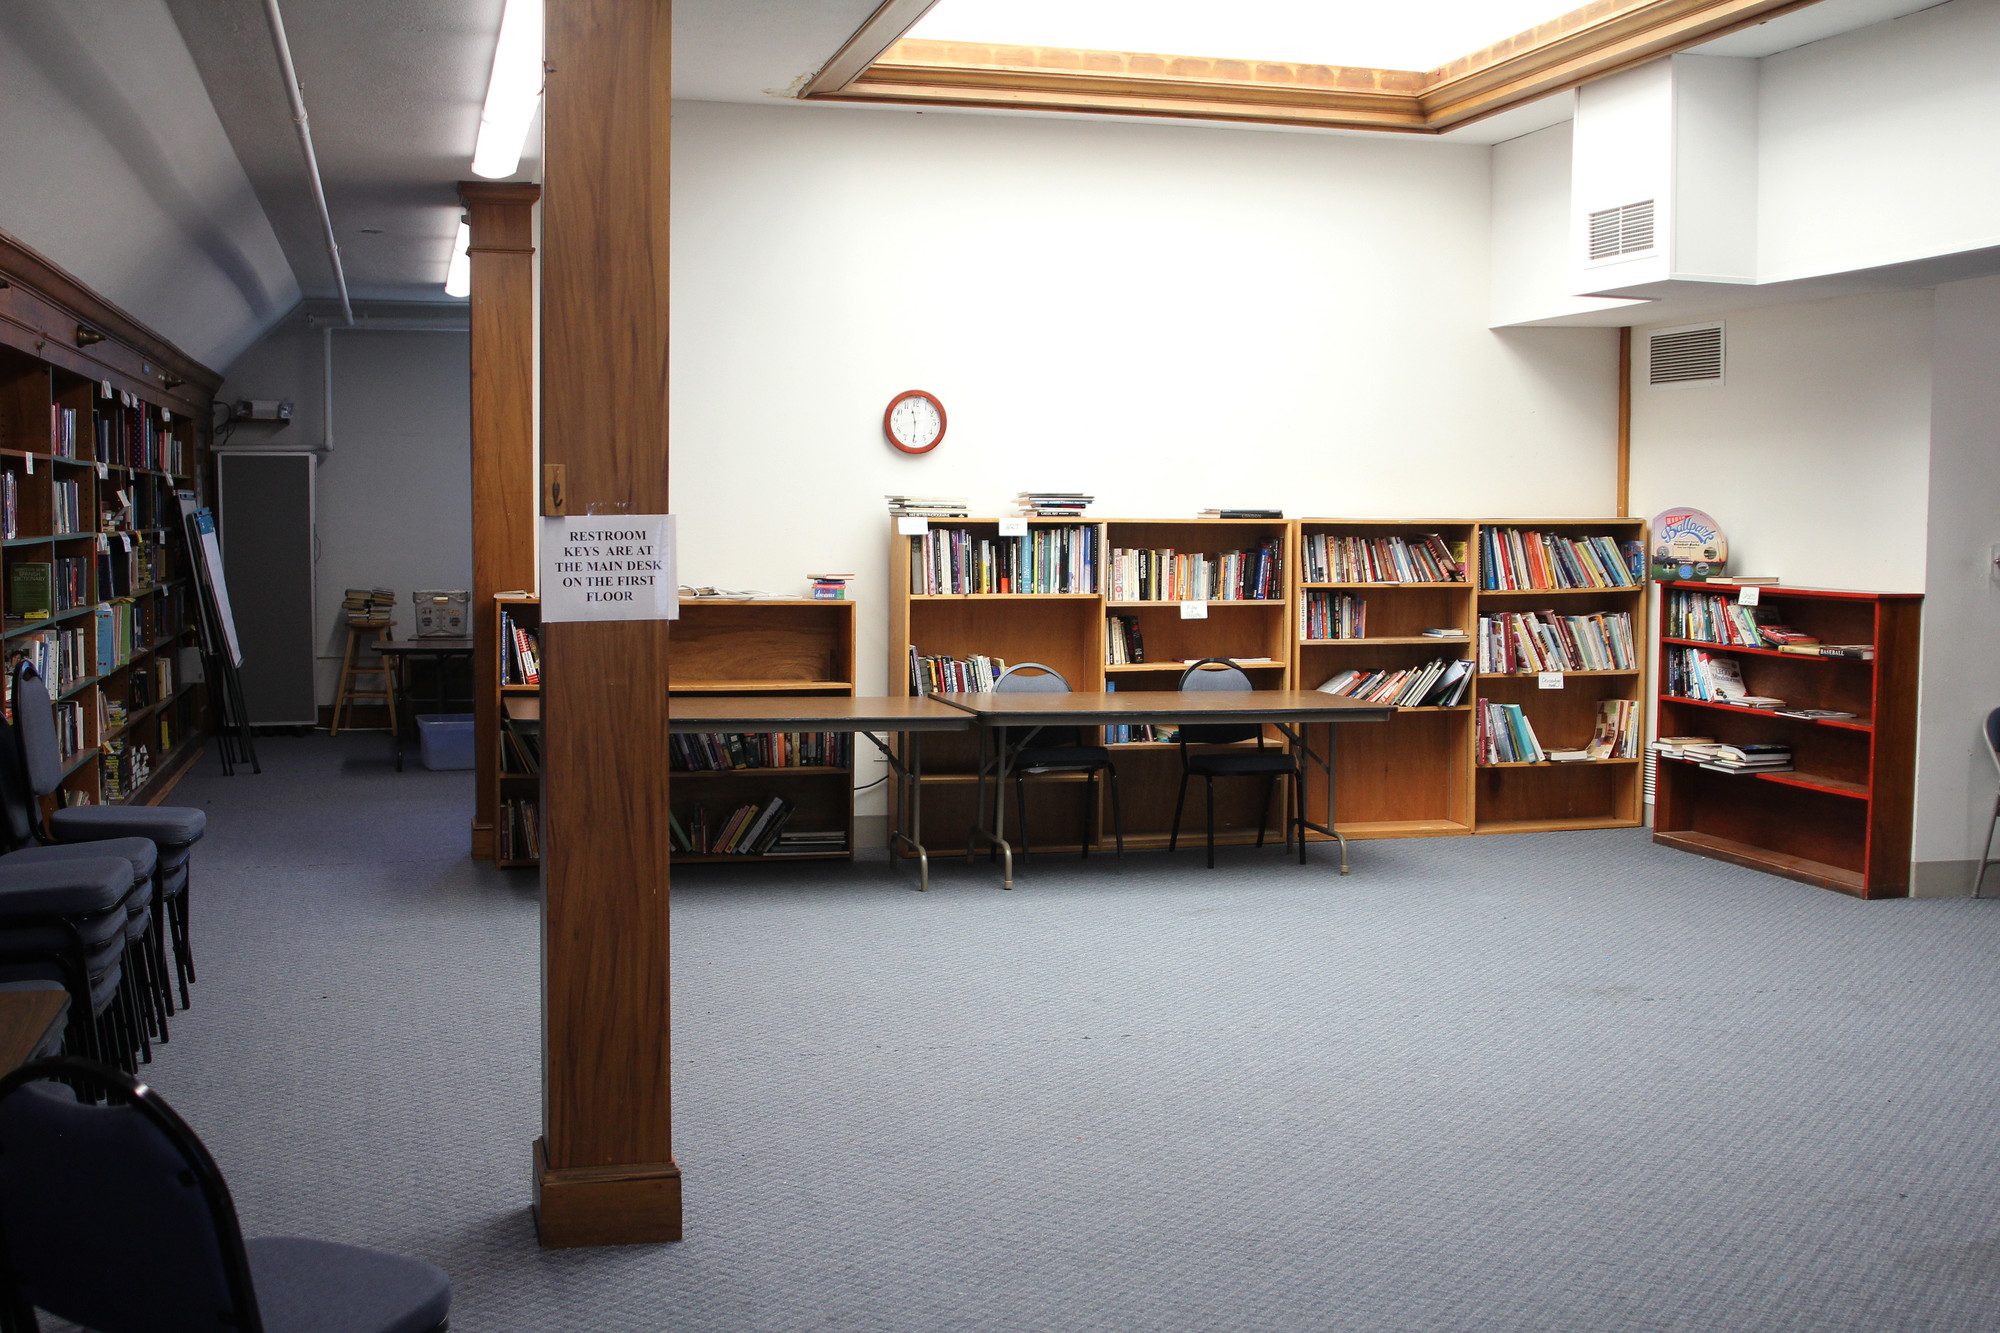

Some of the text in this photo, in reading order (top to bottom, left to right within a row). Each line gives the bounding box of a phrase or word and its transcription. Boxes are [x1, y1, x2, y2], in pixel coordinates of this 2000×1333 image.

[570, 530, 646, 541] RESTROOM
[1661, 517, 1717, 544] Ballpark
[564, 545, 654, 557] KEYS ARE AT
[555, 560, 662, 572] THE MAIN DESK
[563, 575, 655, 587] ON THE FIRST
[586, 591, 634, 602] FLOOR
